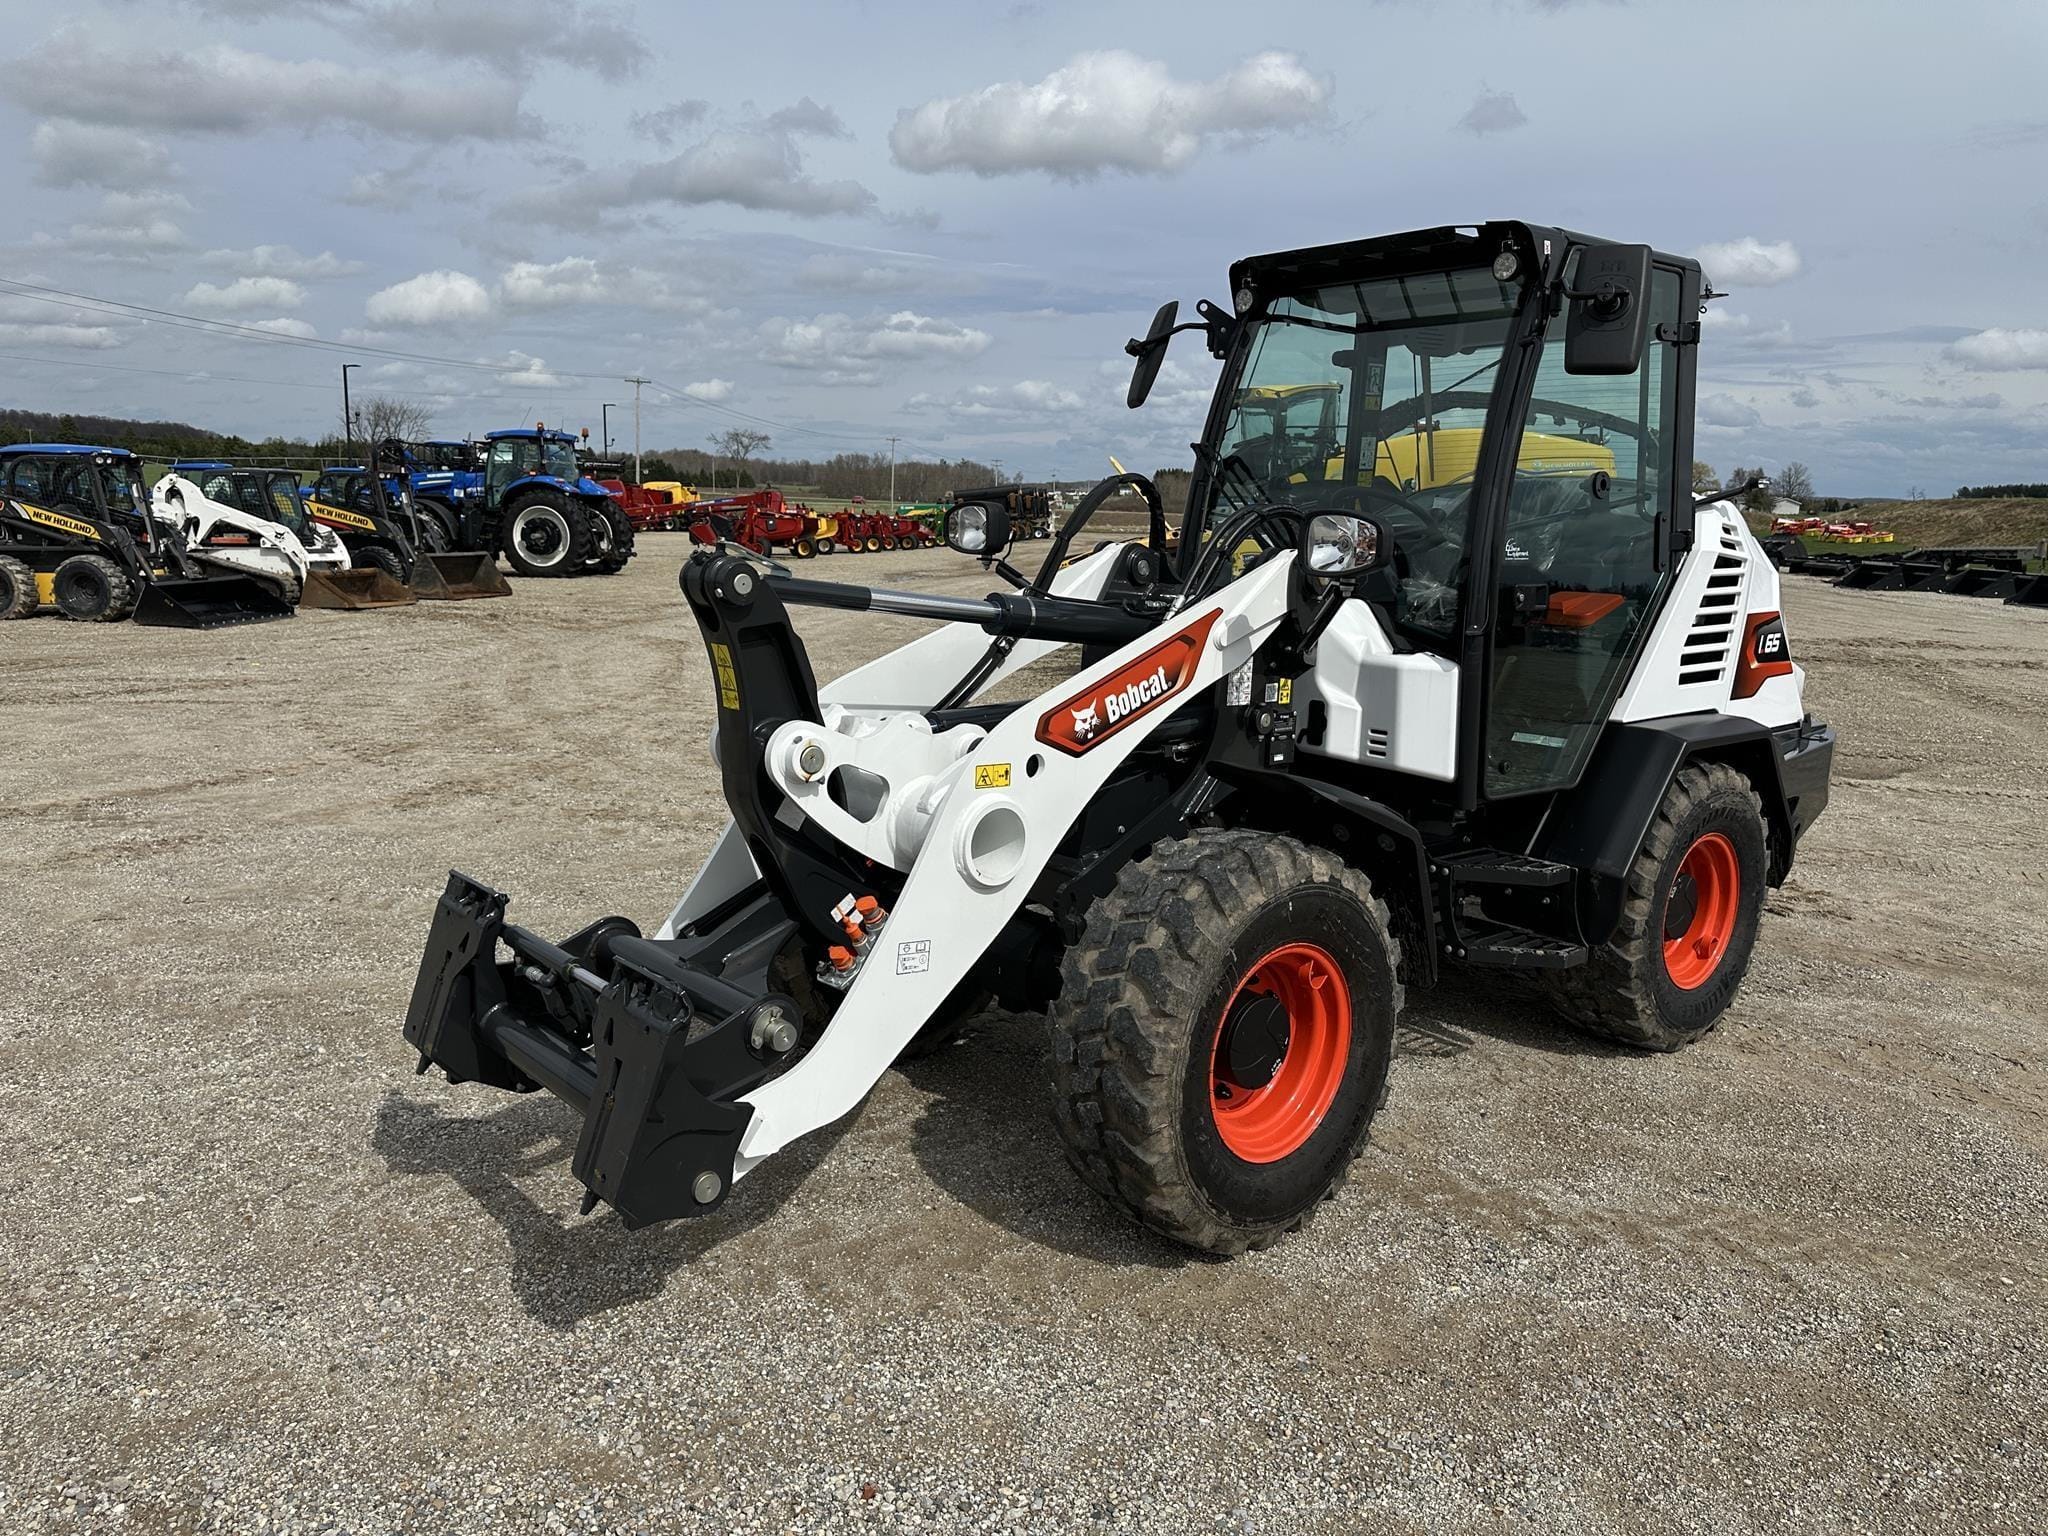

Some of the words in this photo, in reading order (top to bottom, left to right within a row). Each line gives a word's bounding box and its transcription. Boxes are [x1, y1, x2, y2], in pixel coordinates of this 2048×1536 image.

[32, 510, 52, 522] NEW
[53, 517, 91, 534] HOLLAND
[316, 506, 334, 517] NEW
[334, 510, 369, 526] HOLLAND
[1104, 665, 1169, 724] Bobcat
